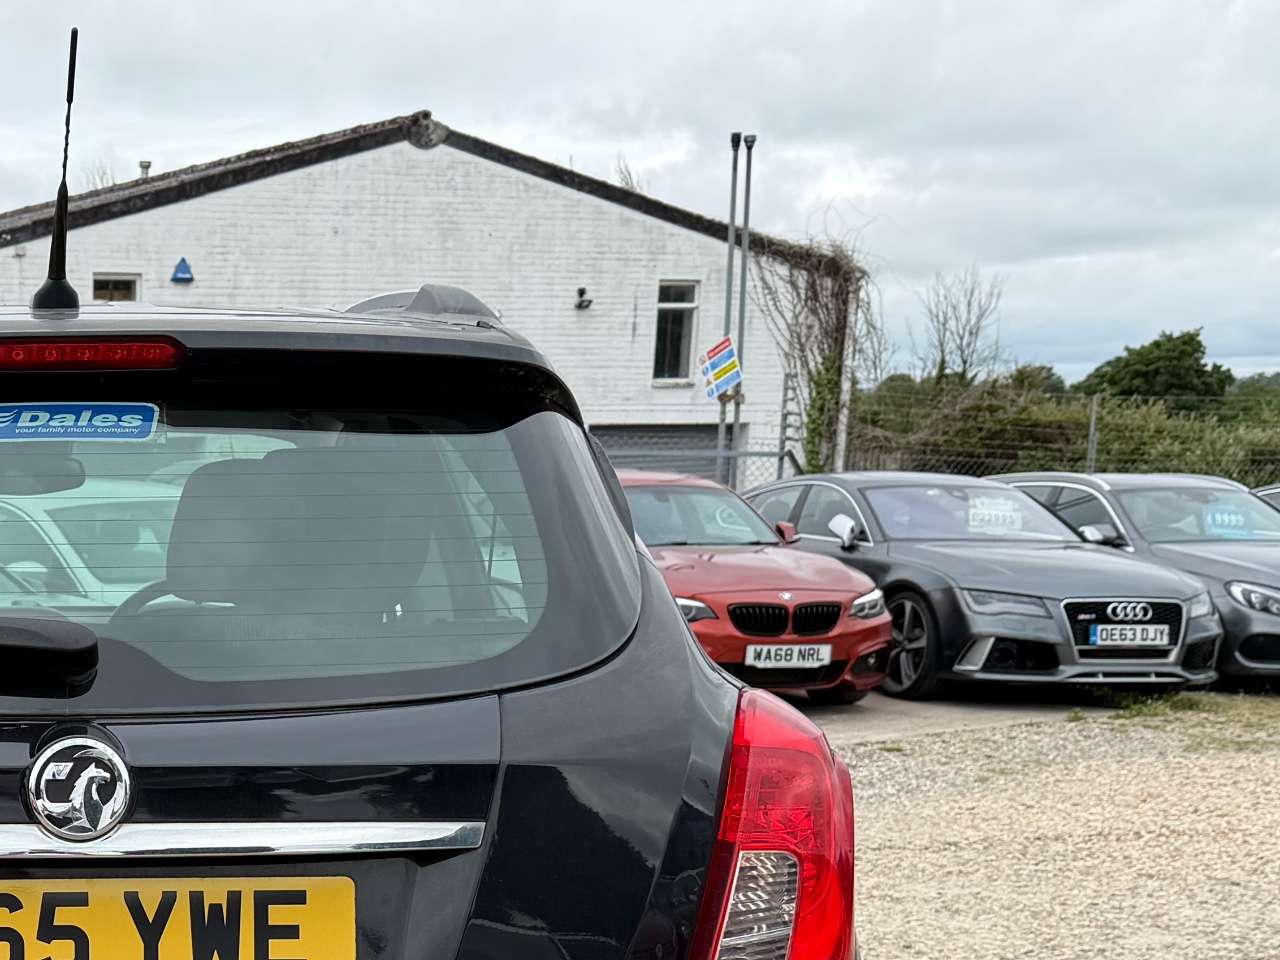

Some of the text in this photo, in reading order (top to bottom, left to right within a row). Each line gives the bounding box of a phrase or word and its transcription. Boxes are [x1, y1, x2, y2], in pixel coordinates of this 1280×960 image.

[17, 410, 144, 427] Dales
[1100, 627, 1166, 641] OE63 DJY
[753, 647, 824, 662] WA68 NRL
